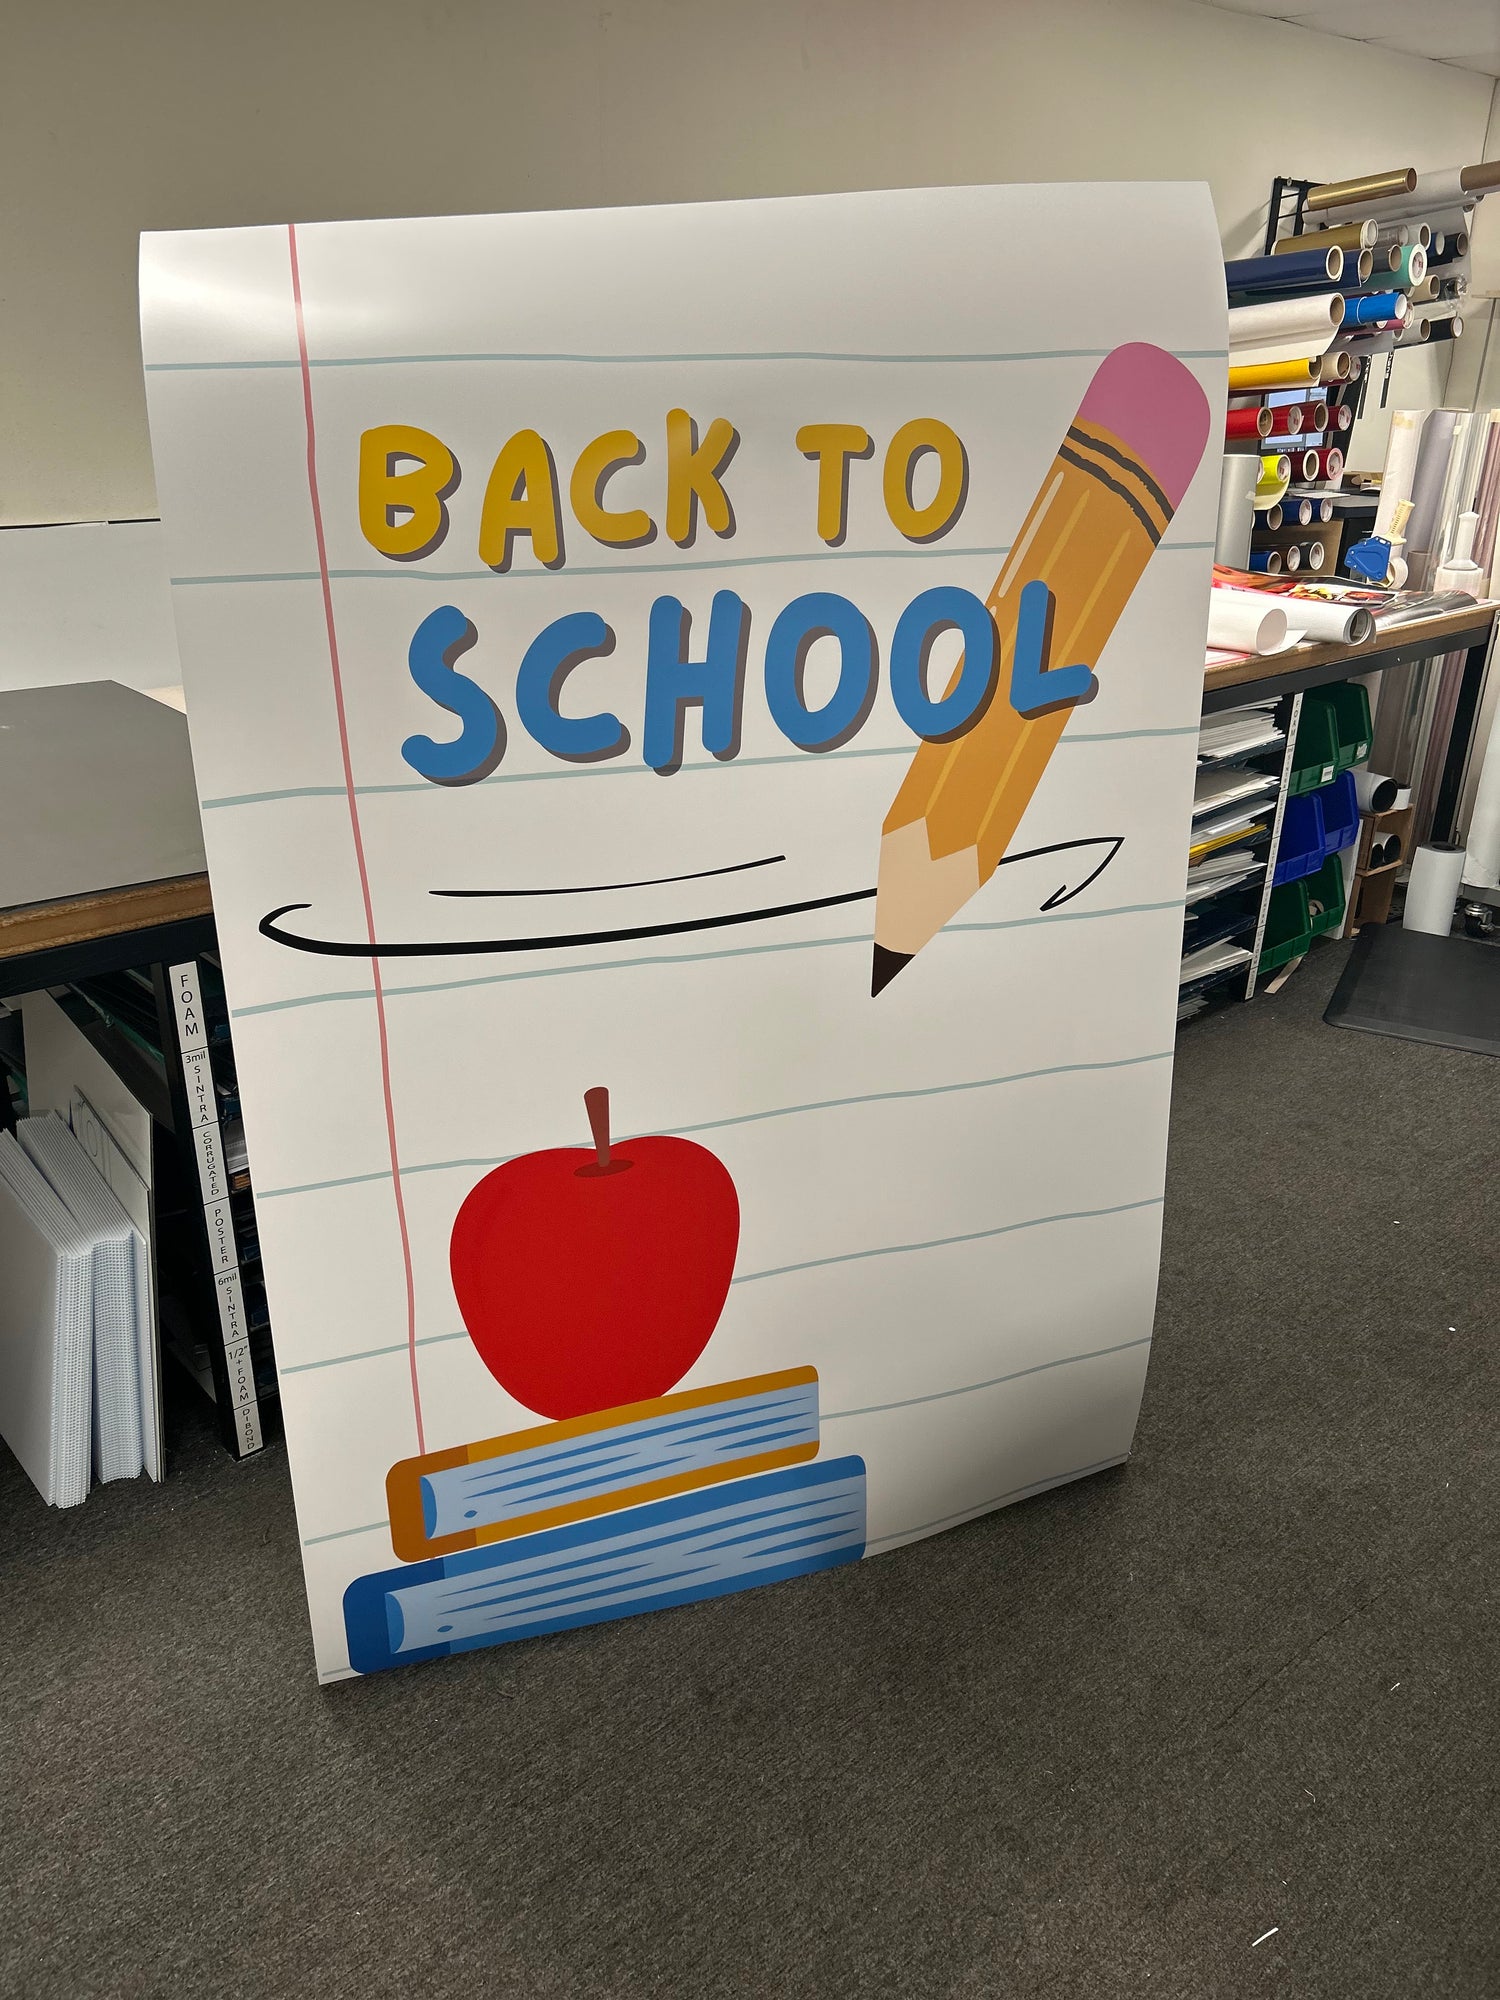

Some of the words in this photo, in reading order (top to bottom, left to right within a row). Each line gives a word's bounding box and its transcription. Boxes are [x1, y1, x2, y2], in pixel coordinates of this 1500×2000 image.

[358, 408, 741, 572] BACK
[796, 417, 970, 547] TO
[400, 580, 1099, 787] SCHOOL
[180, 975, 199, 1037] FOAM
[185, 1050, 206, 1064] 3mil
[194, 1065, 209, 1123] SINTRA
[202, 1131, 220, 1196] CORRUGATED
[214, 1208, 229, 1264] POSTER
[218, 1272, 237, 1286] 6mil
[226, 1286, 240, 1338] SINTRA
[237, 1369, 250, 1402] FOAM
[242, 1408, 255, 1450] DIBOND
